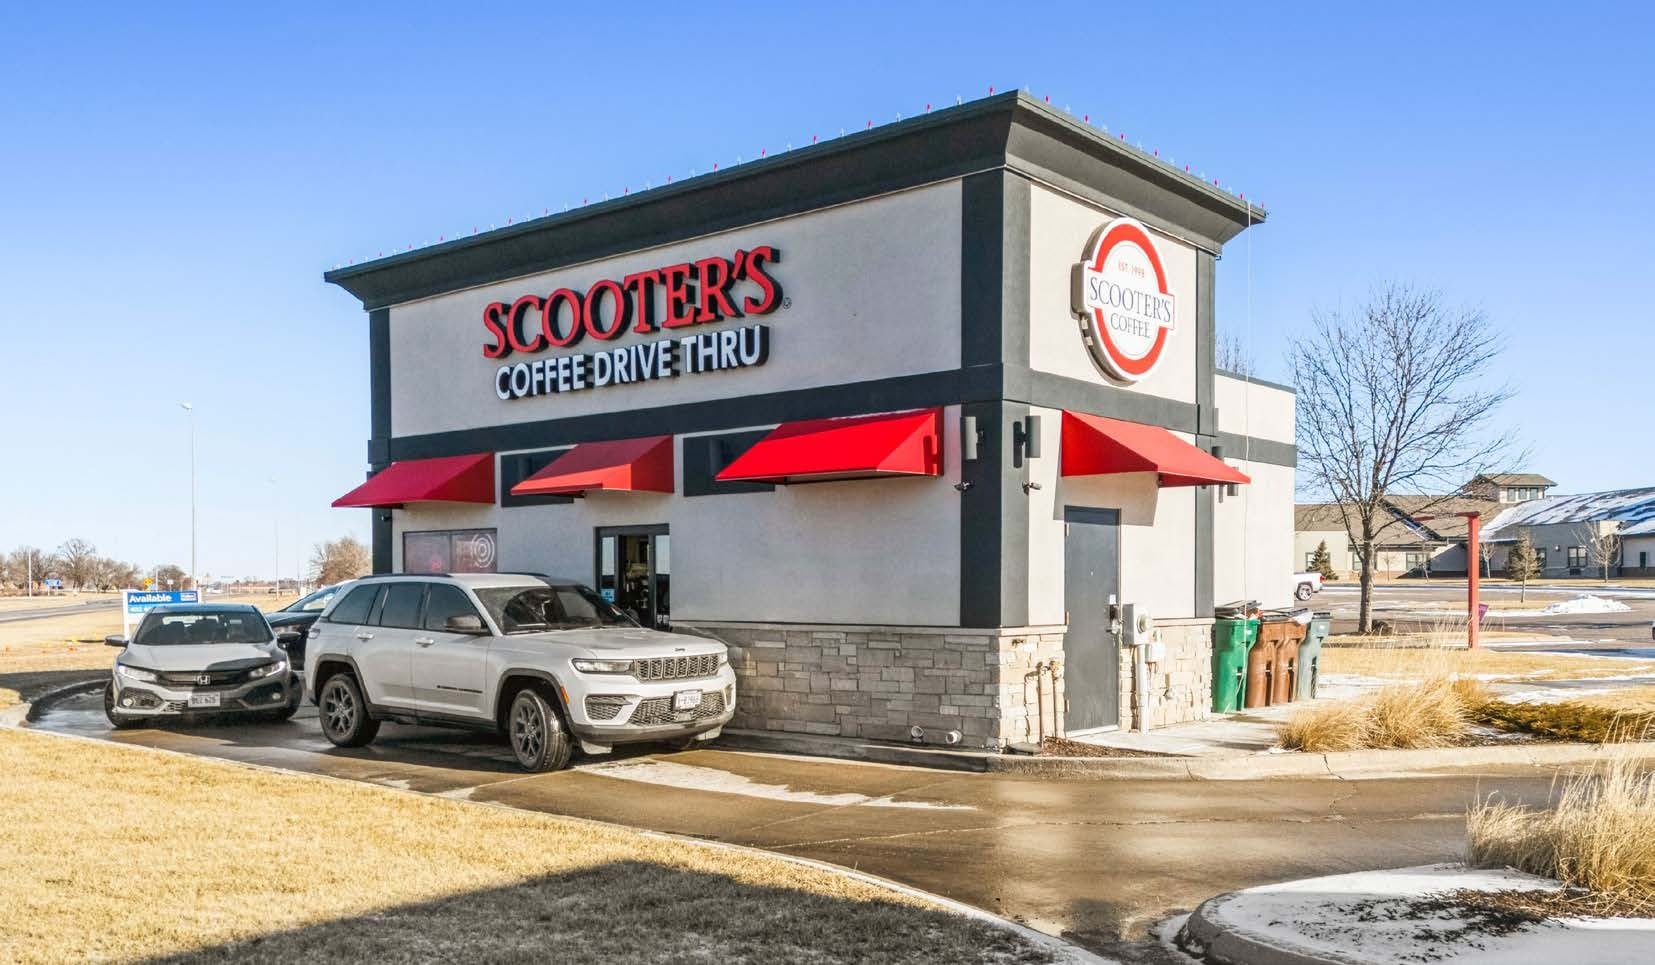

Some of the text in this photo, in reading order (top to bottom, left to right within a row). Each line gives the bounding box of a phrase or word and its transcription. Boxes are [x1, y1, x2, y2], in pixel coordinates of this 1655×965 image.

[483, 245, 781, 358] SCOOTER'S
[1090, 276, 1171, 323] SCOOTER'S
[1110, 312, 1150, 338] COFFEE
[495, 324, 766, 400] COFFEE DRIVE THRU
[129, 593, 172, 603] Available
